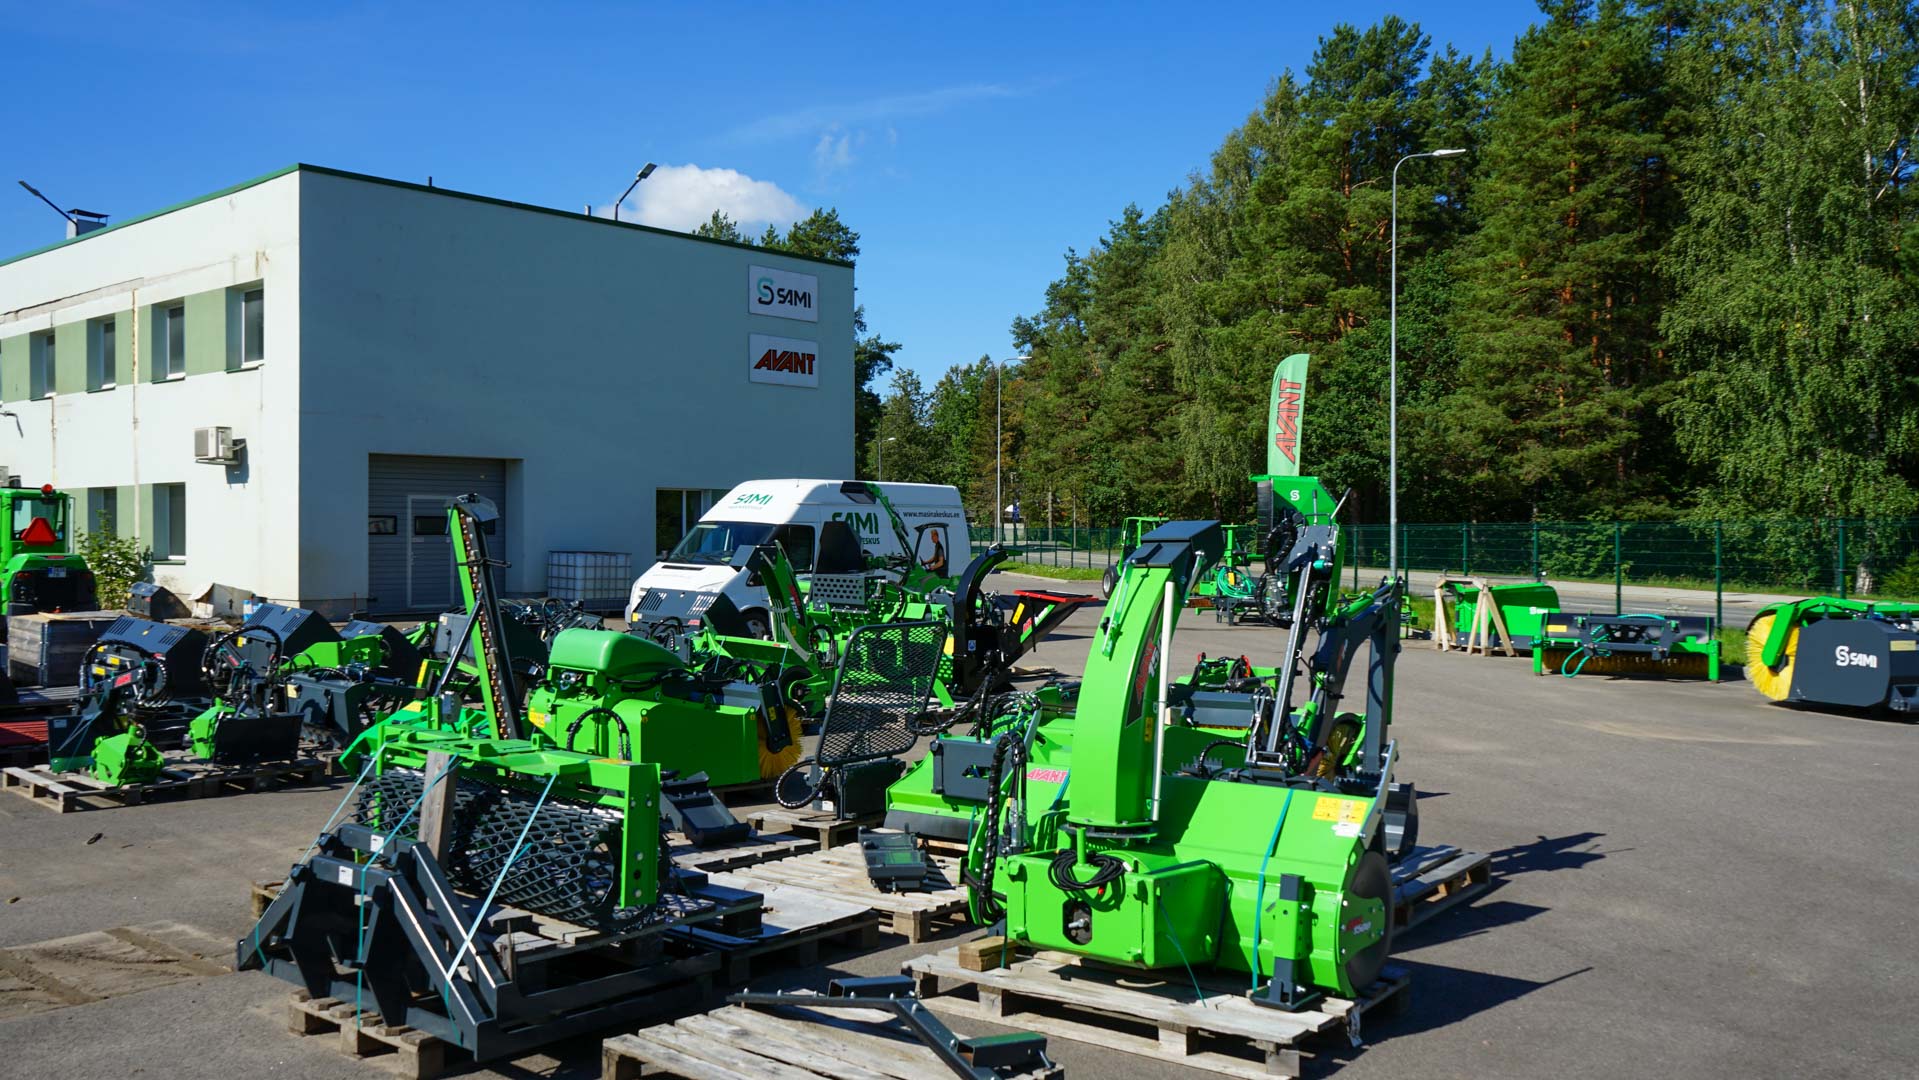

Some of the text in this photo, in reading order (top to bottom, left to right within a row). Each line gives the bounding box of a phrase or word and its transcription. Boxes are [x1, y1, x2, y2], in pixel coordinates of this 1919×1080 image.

[777, 287, 812, 309] SAMI
[753, 348, 816, 376] AVANT
[1275, 378, 1302, 466] AVANT
[733, 493, 774, 506] SAMI
[1849, 652, 1878, 669] SAMI
[1026, 767, 1068, 785] AVANT
